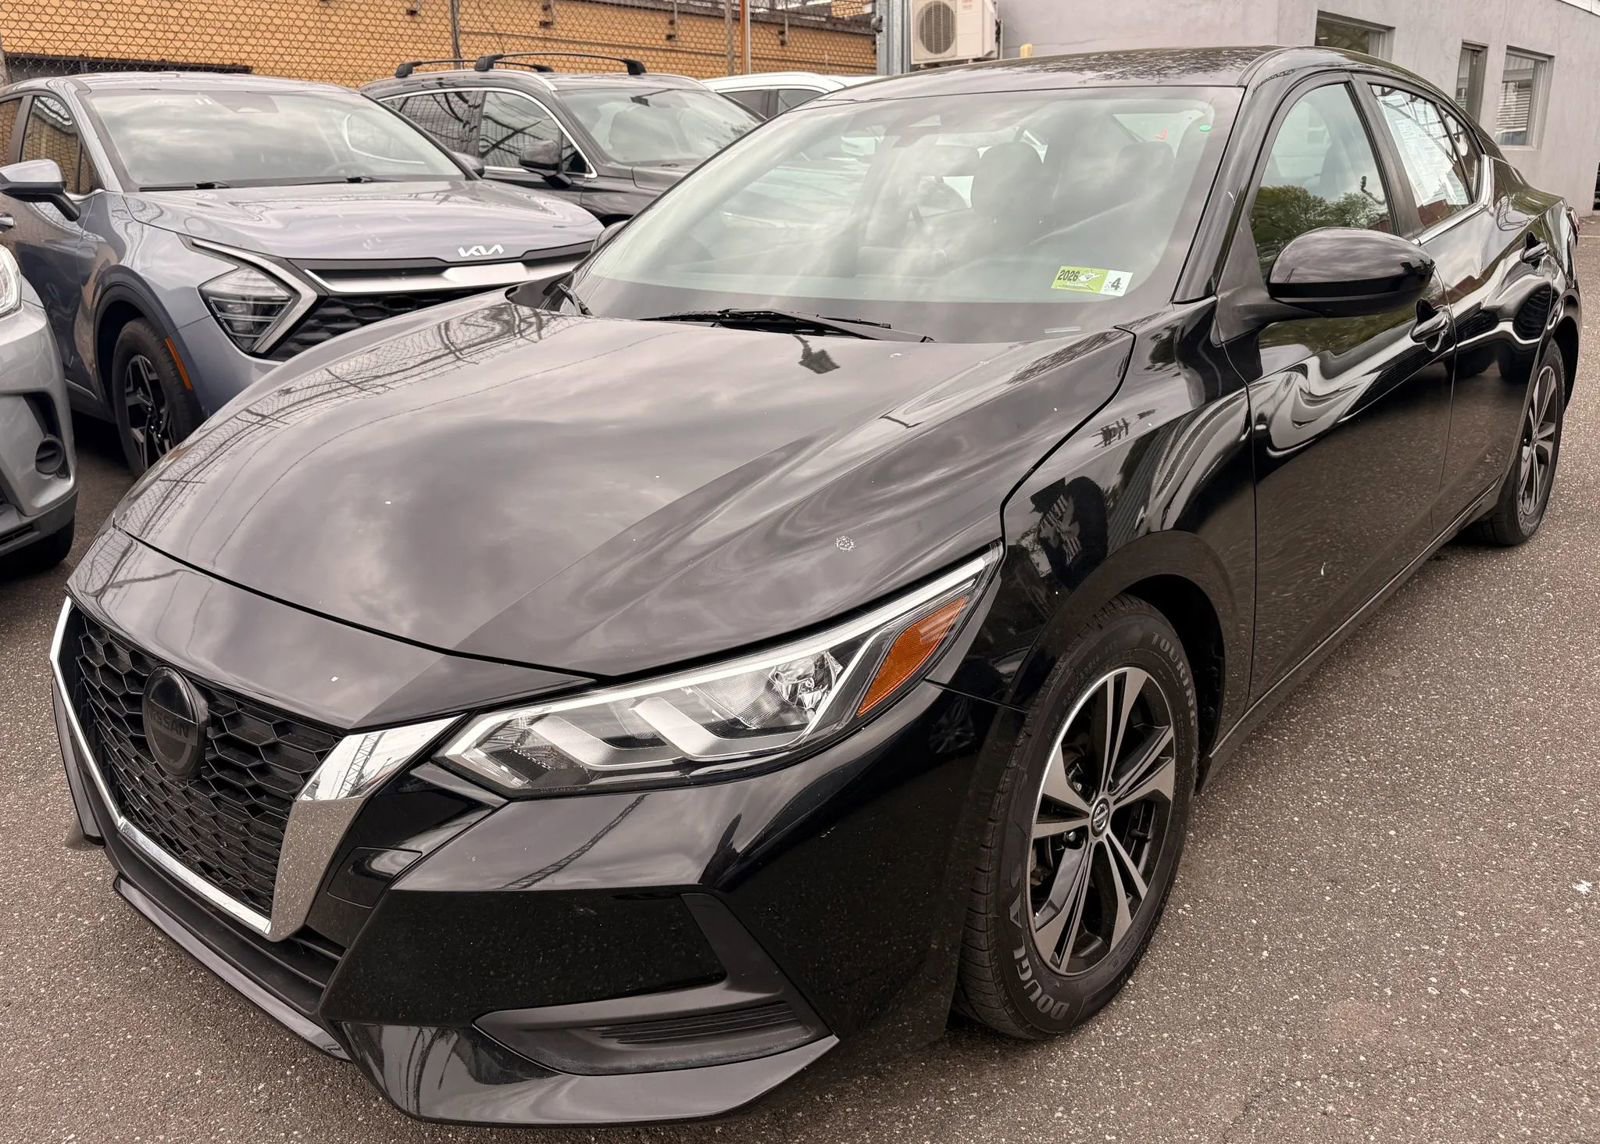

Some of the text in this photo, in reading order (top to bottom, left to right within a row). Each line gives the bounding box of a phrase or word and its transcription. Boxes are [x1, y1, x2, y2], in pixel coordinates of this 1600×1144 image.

[458, 244, 504, 257] KIA
[1057, 269, 1080, 282] 2026
[1111, 277, 1122, 290] 4
[1151, 631, 1196, 727] TOURING
